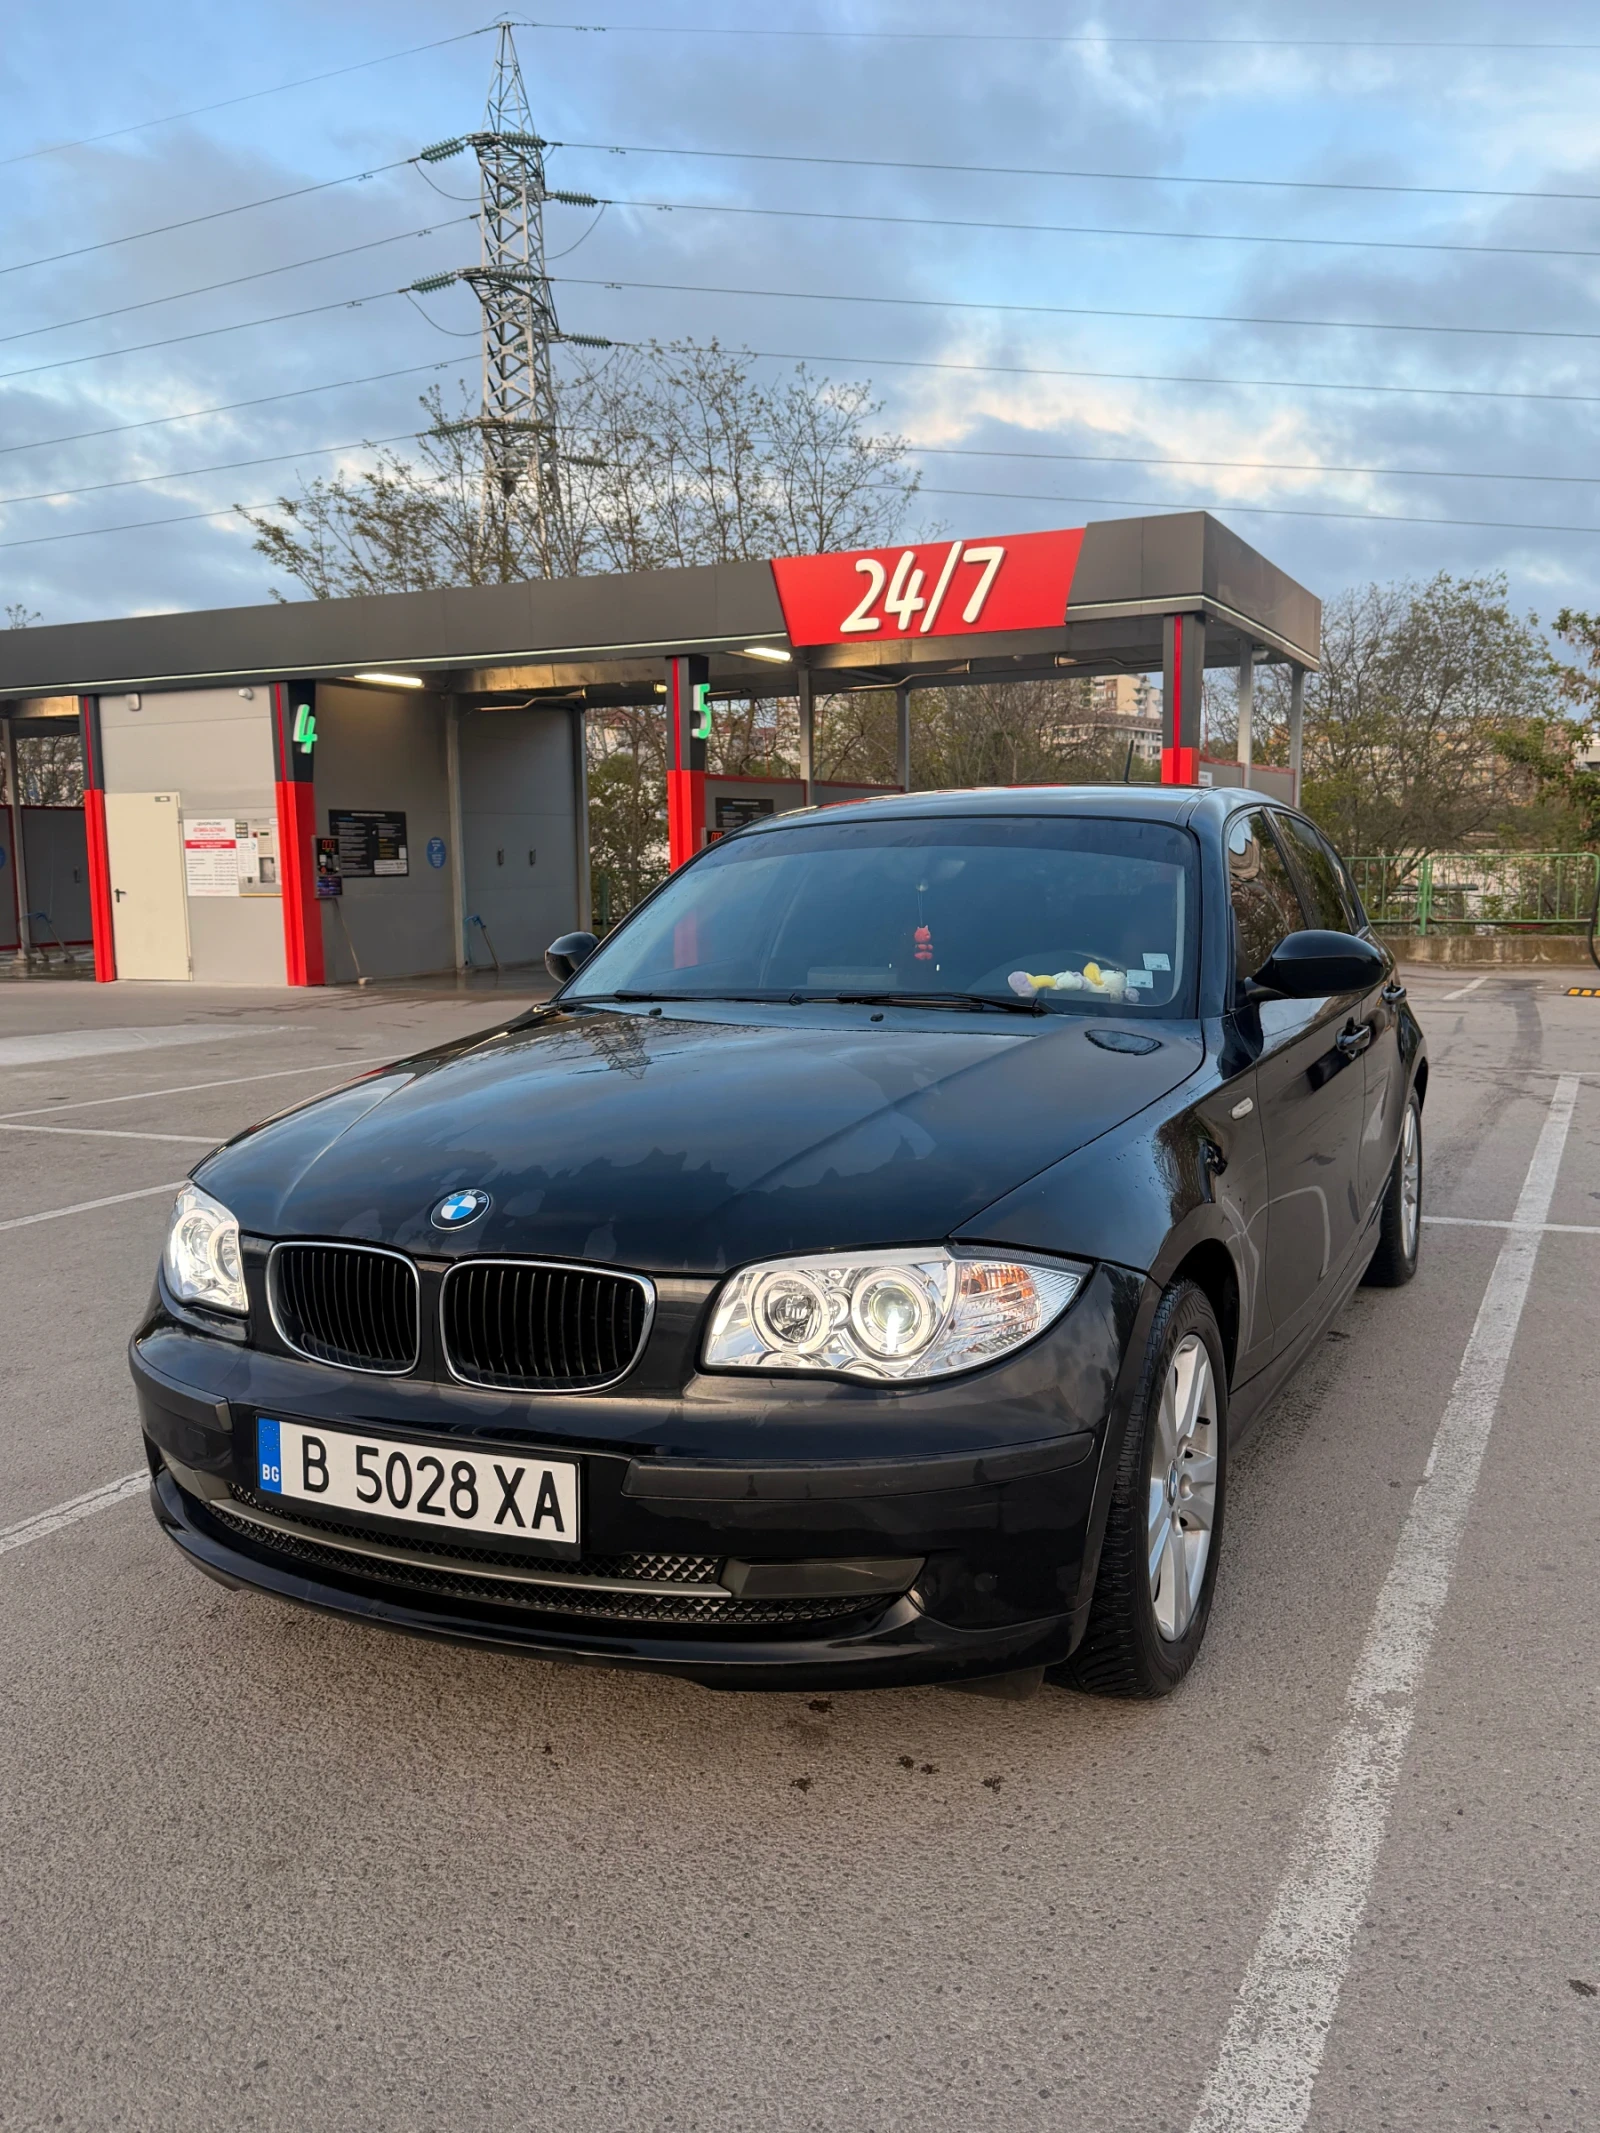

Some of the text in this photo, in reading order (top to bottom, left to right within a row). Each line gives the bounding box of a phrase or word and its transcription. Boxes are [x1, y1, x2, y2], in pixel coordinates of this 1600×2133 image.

[840, 541, 1005, 633] 24/7
[293, 704, 318, 754] 4
[692, 684, 711, 738] 5
[262, 1463, 280, 1483] BG
[302, 1434, 566, 1532] B 5028 XA
